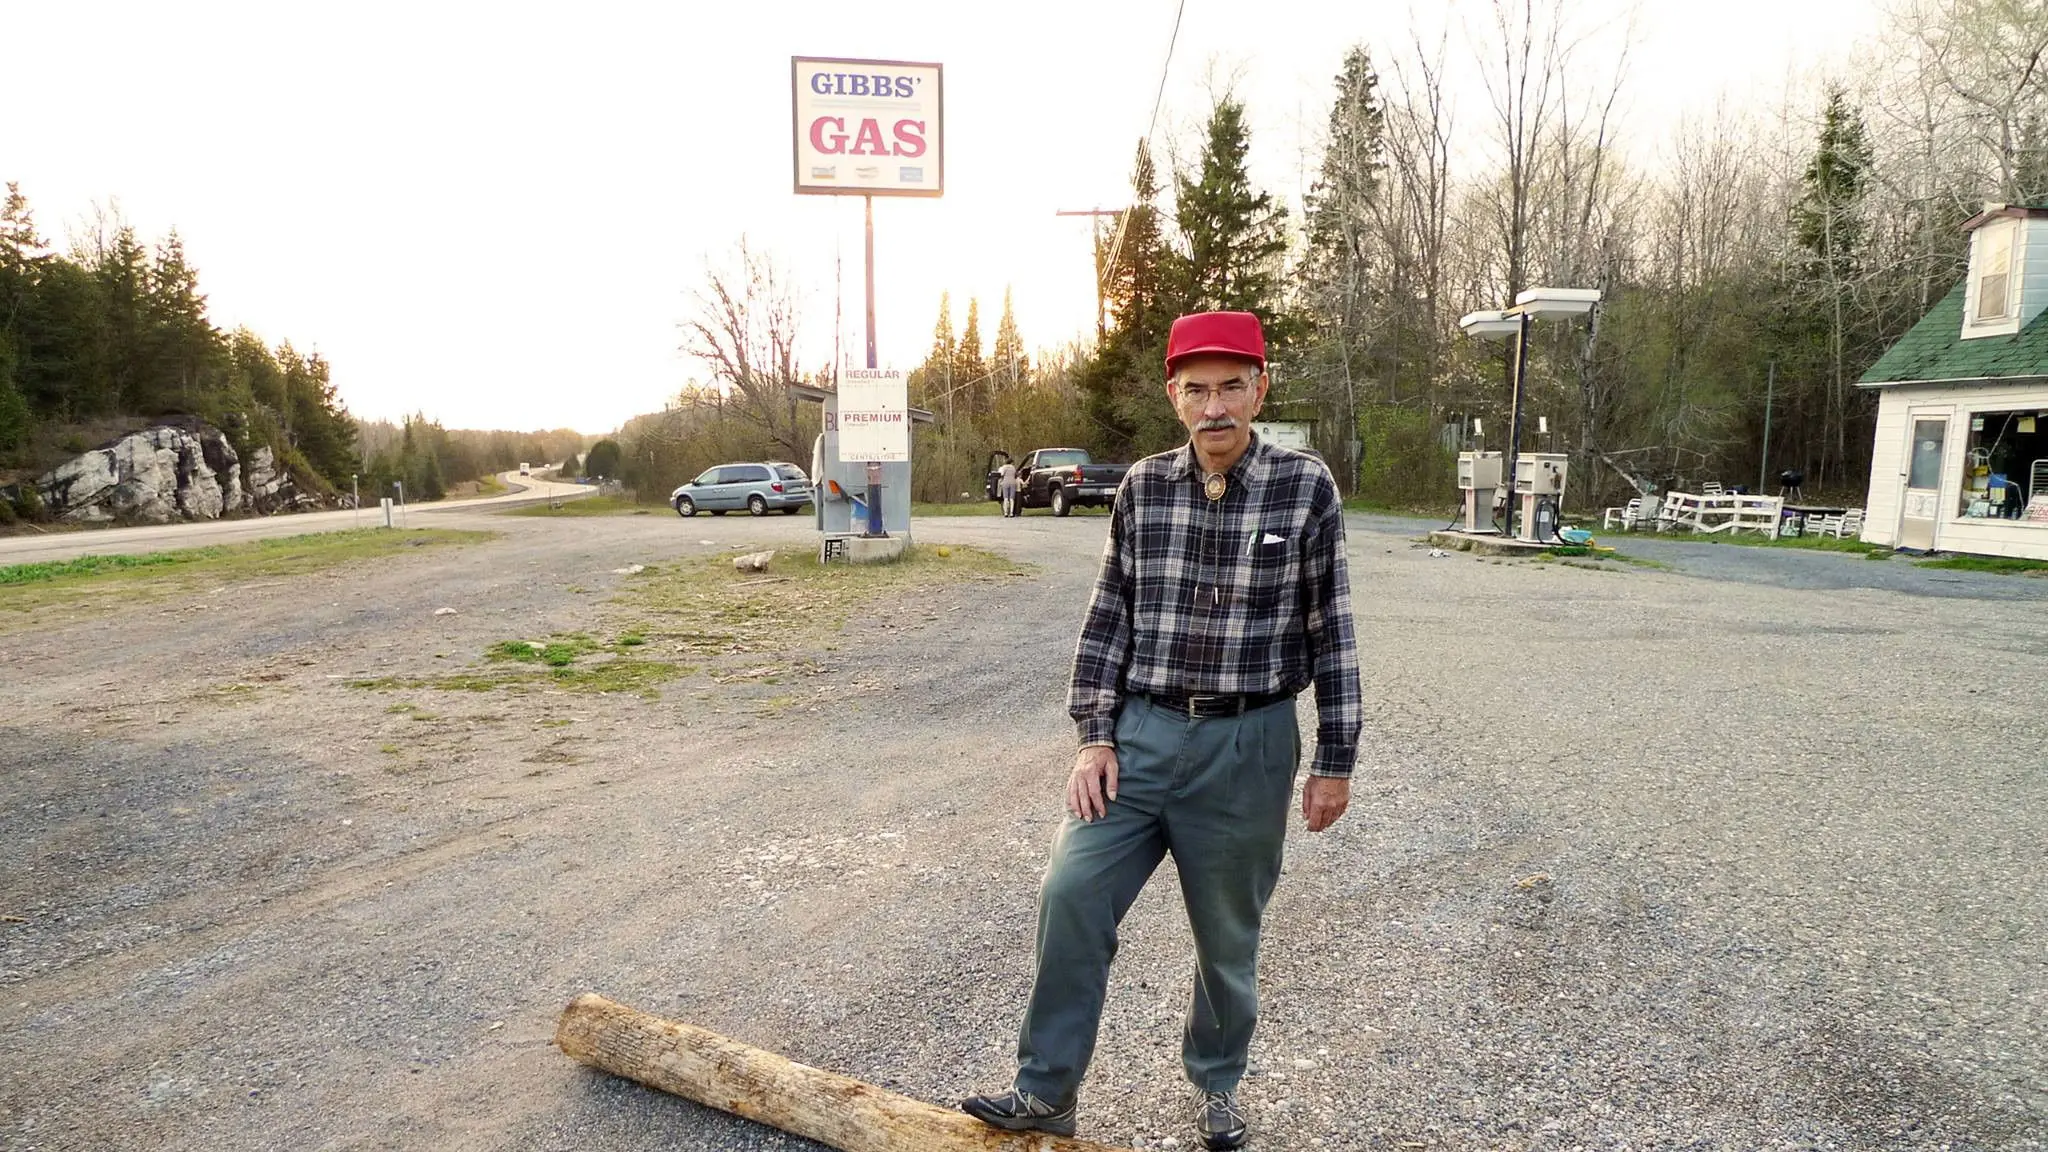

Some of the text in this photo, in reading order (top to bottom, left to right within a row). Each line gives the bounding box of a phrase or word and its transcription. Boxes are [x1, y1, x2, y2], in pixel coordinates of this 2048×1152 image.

[811, 72, 921, 98] GIBBS'
[809, 116, 927, 158] GAS
[845, 370, 900, 380] REGULAR
[844, 413, 902, 423] PREMIUM
